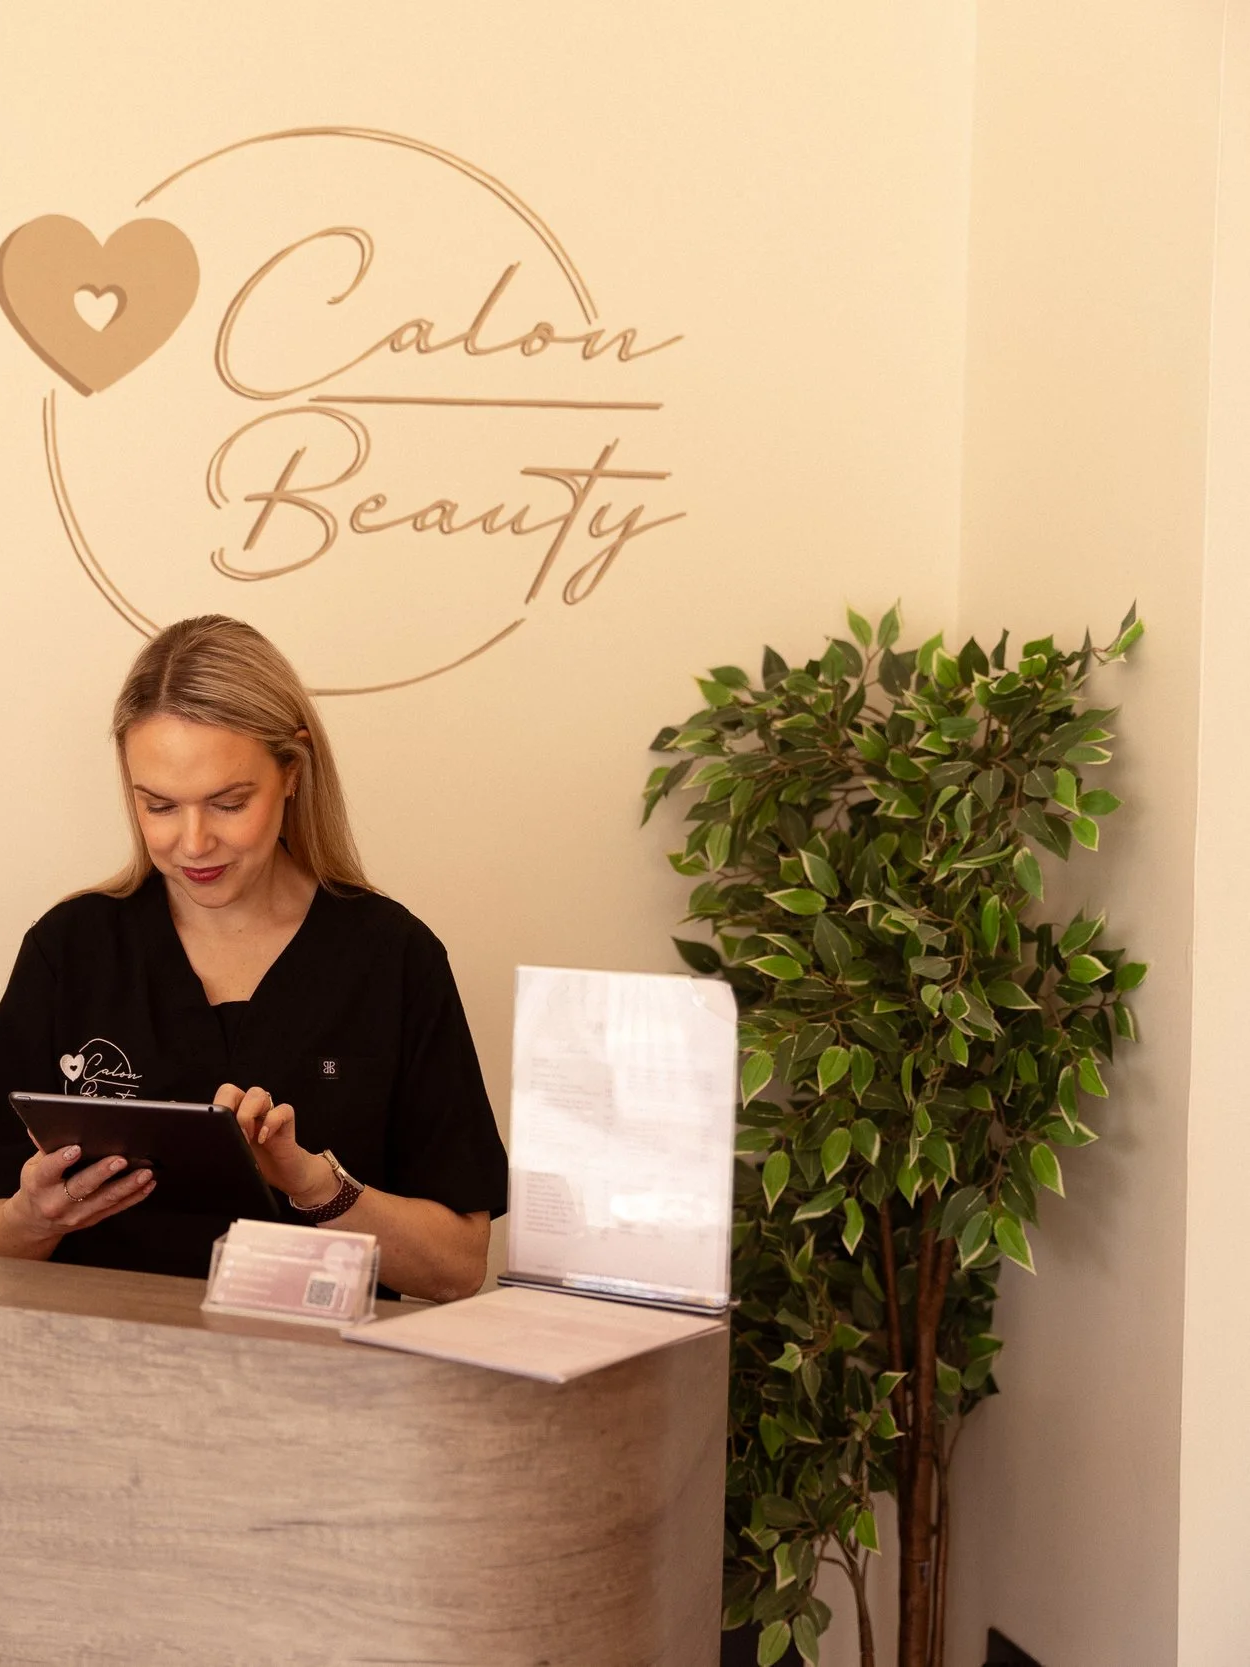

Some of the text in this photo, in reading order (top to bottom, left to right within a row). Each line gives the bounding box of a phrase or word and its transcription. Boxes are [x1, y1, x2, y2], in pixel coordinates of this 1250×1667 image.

[214, 226, 684, 400] Calon
[206, 405, 687, 605] Beauty
[83, 1052, 143, 1080] Calon
